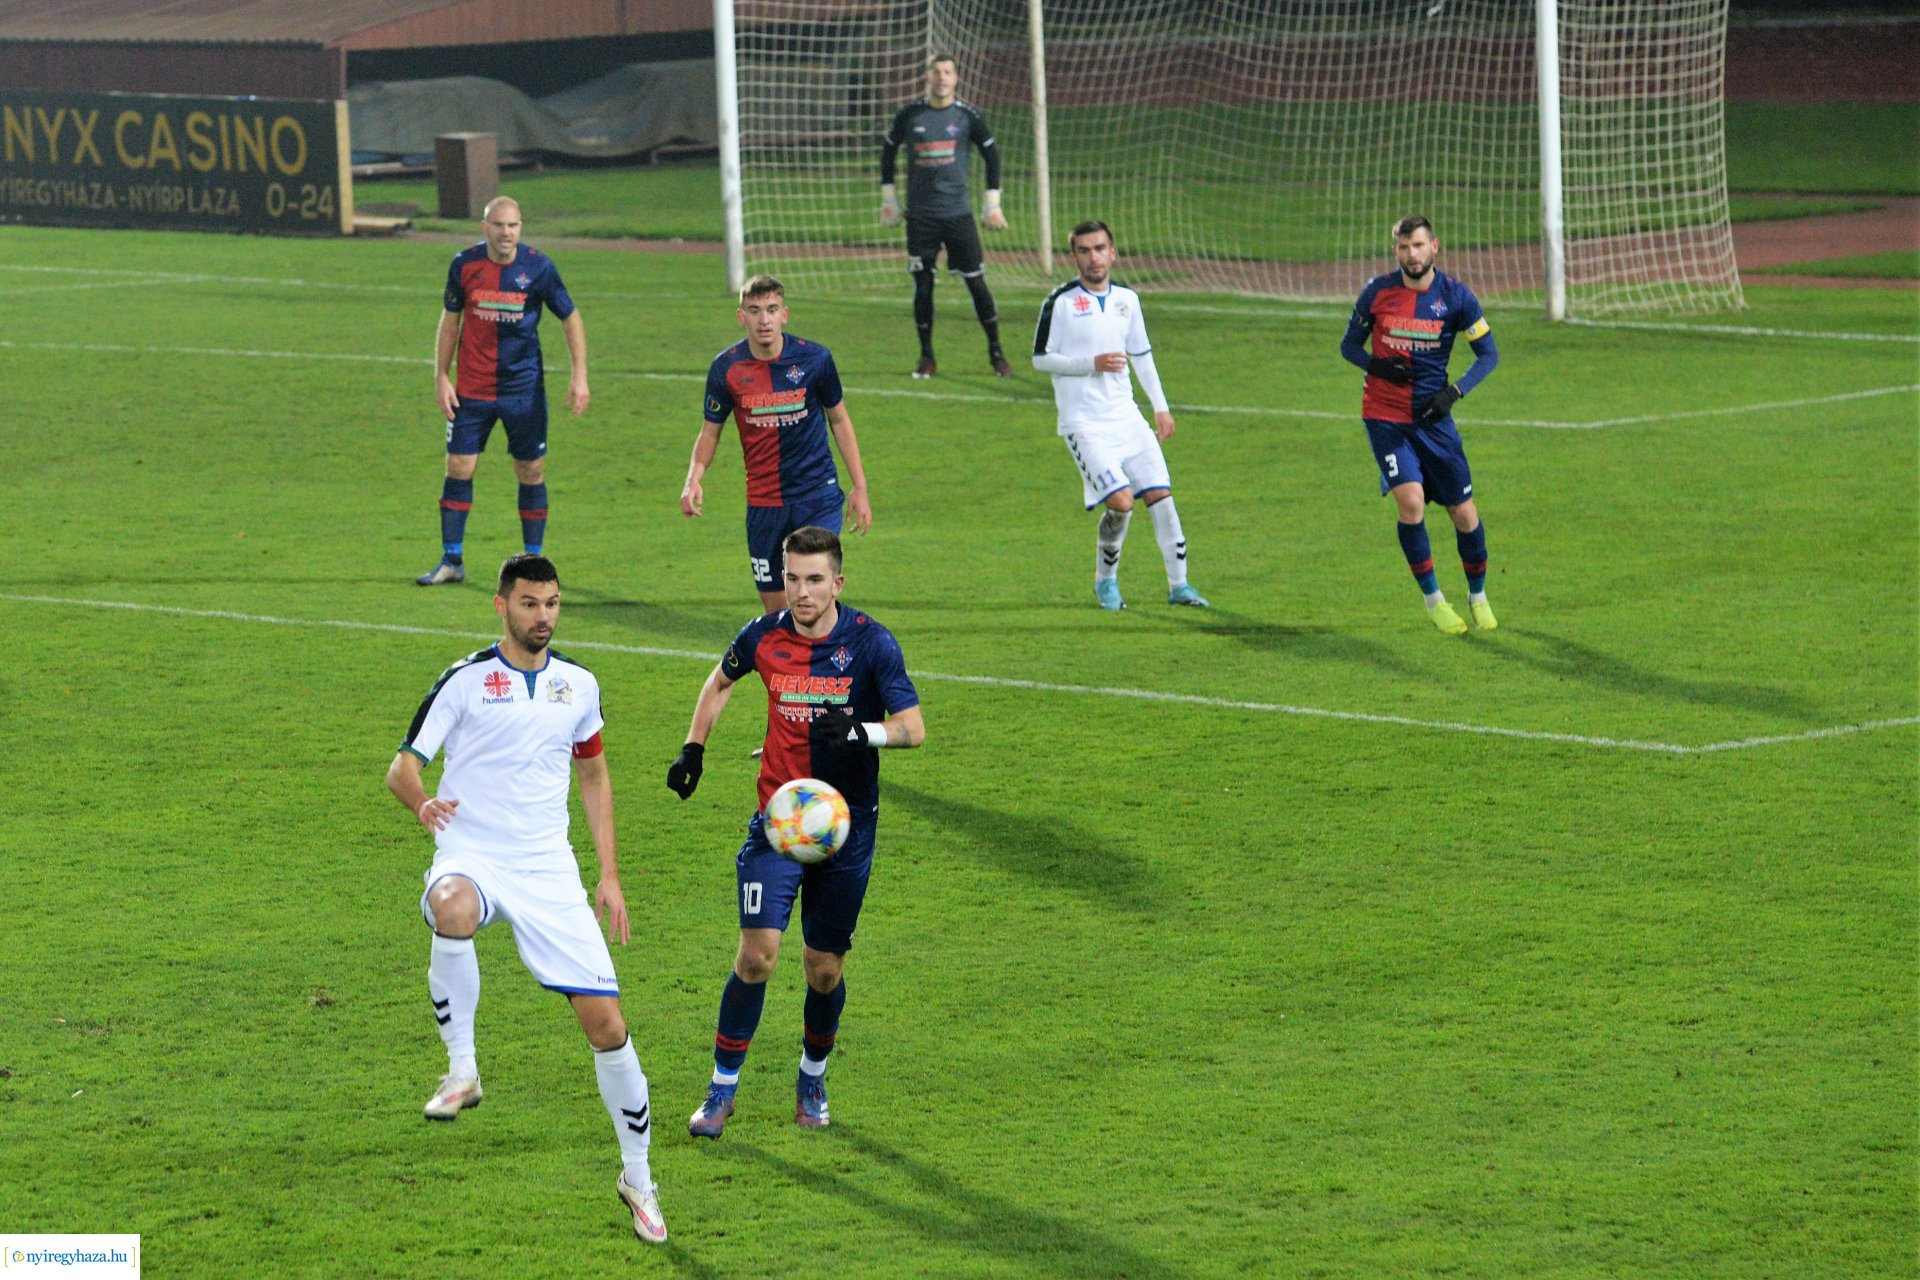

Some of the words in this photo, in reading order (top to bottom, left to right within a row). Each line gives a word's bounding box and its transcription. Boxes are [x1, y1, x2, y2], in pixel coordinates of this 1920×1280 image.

[3, 105, 102, 166] NYX
[114, 109, 308, 175] CASINO
[266, 182, 334, 219] 0-24
[741, 387, 806, 408] REVESZ
[1385, 453, 1399, 478] 3
[1097, 469, 1117, 490] 11
[751, 557, 773, 583] 32
[770, 674, 853, 695] REVESZ
[482, 696, 514, 705] hummel
[743, 882, 763, 915] 10
